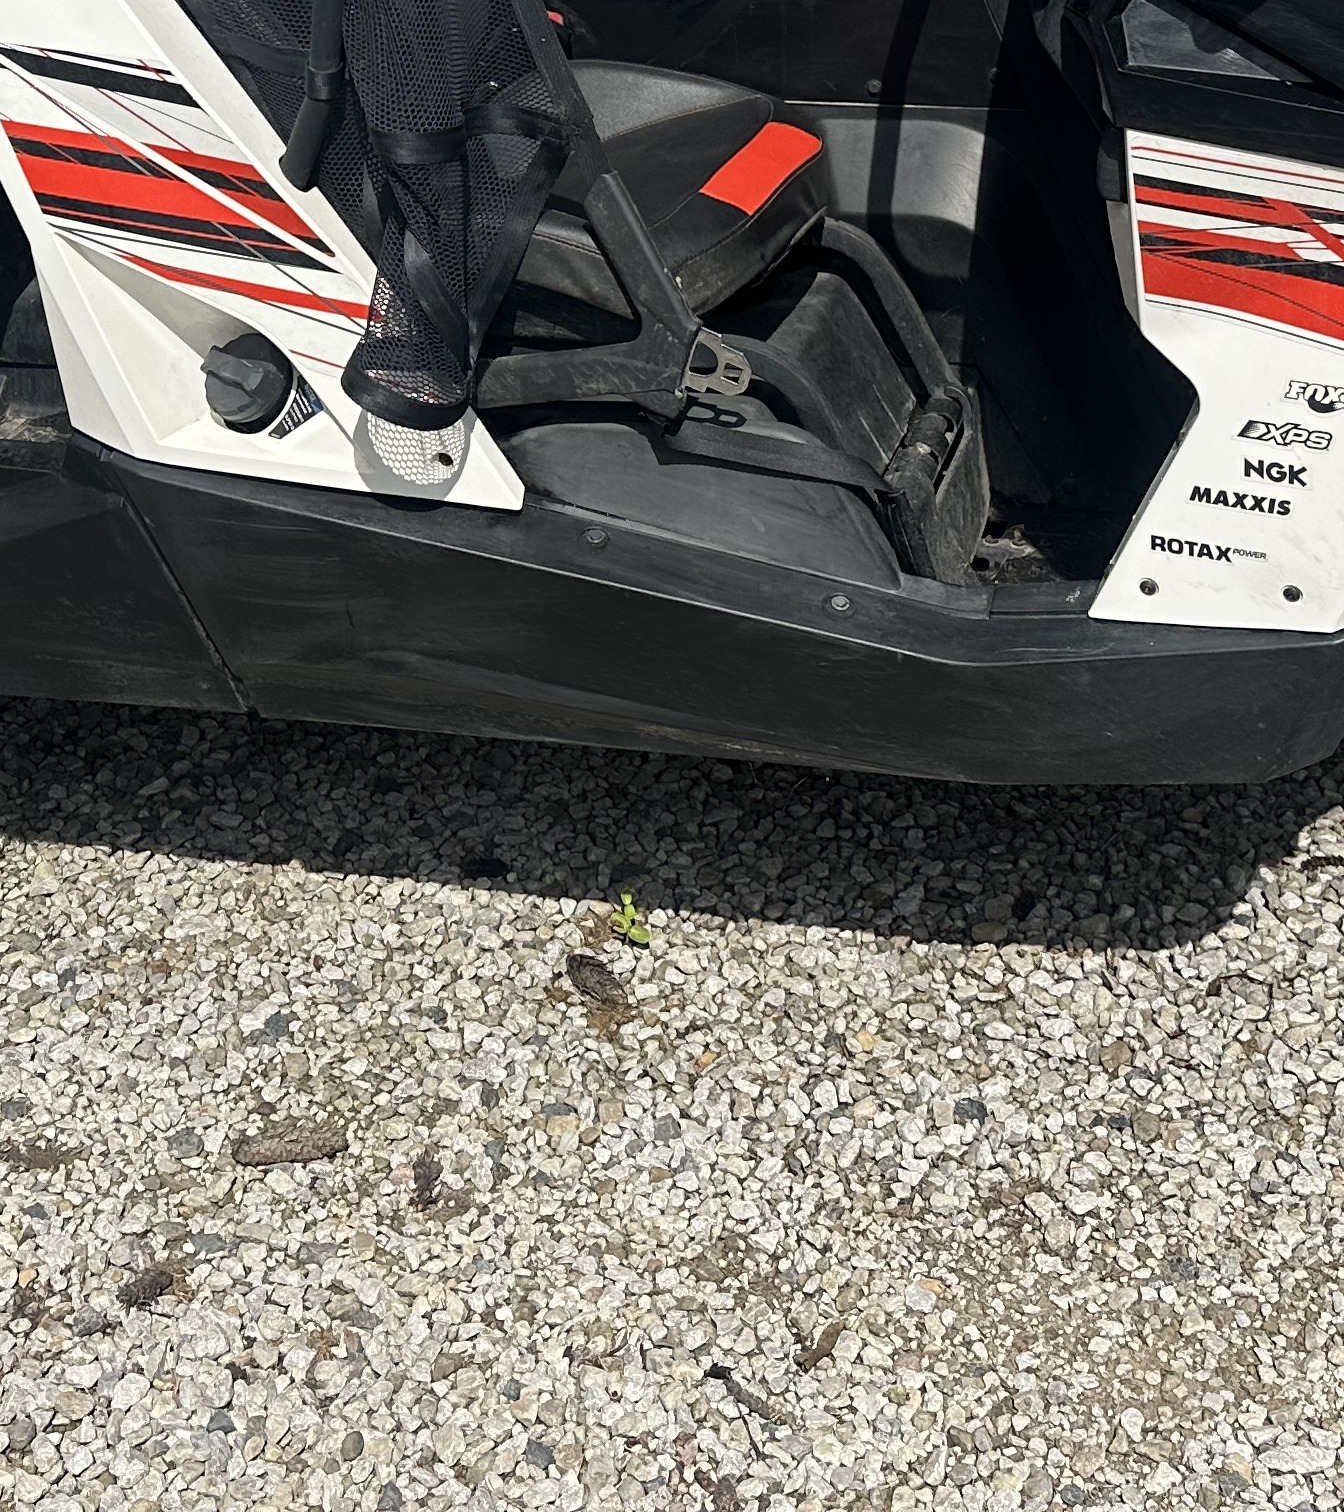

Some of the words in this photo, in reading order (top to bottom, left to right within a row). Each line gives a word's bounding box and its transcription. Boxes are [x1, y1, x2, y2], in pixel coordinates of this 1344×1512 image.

[1259, 421, 1334, 451] XPS
[1243, 457, 1308, 487] NGK
[1189, 485, 1291, 516] MAXXIS
[1150, 534, 1233, 563] ROTAX
